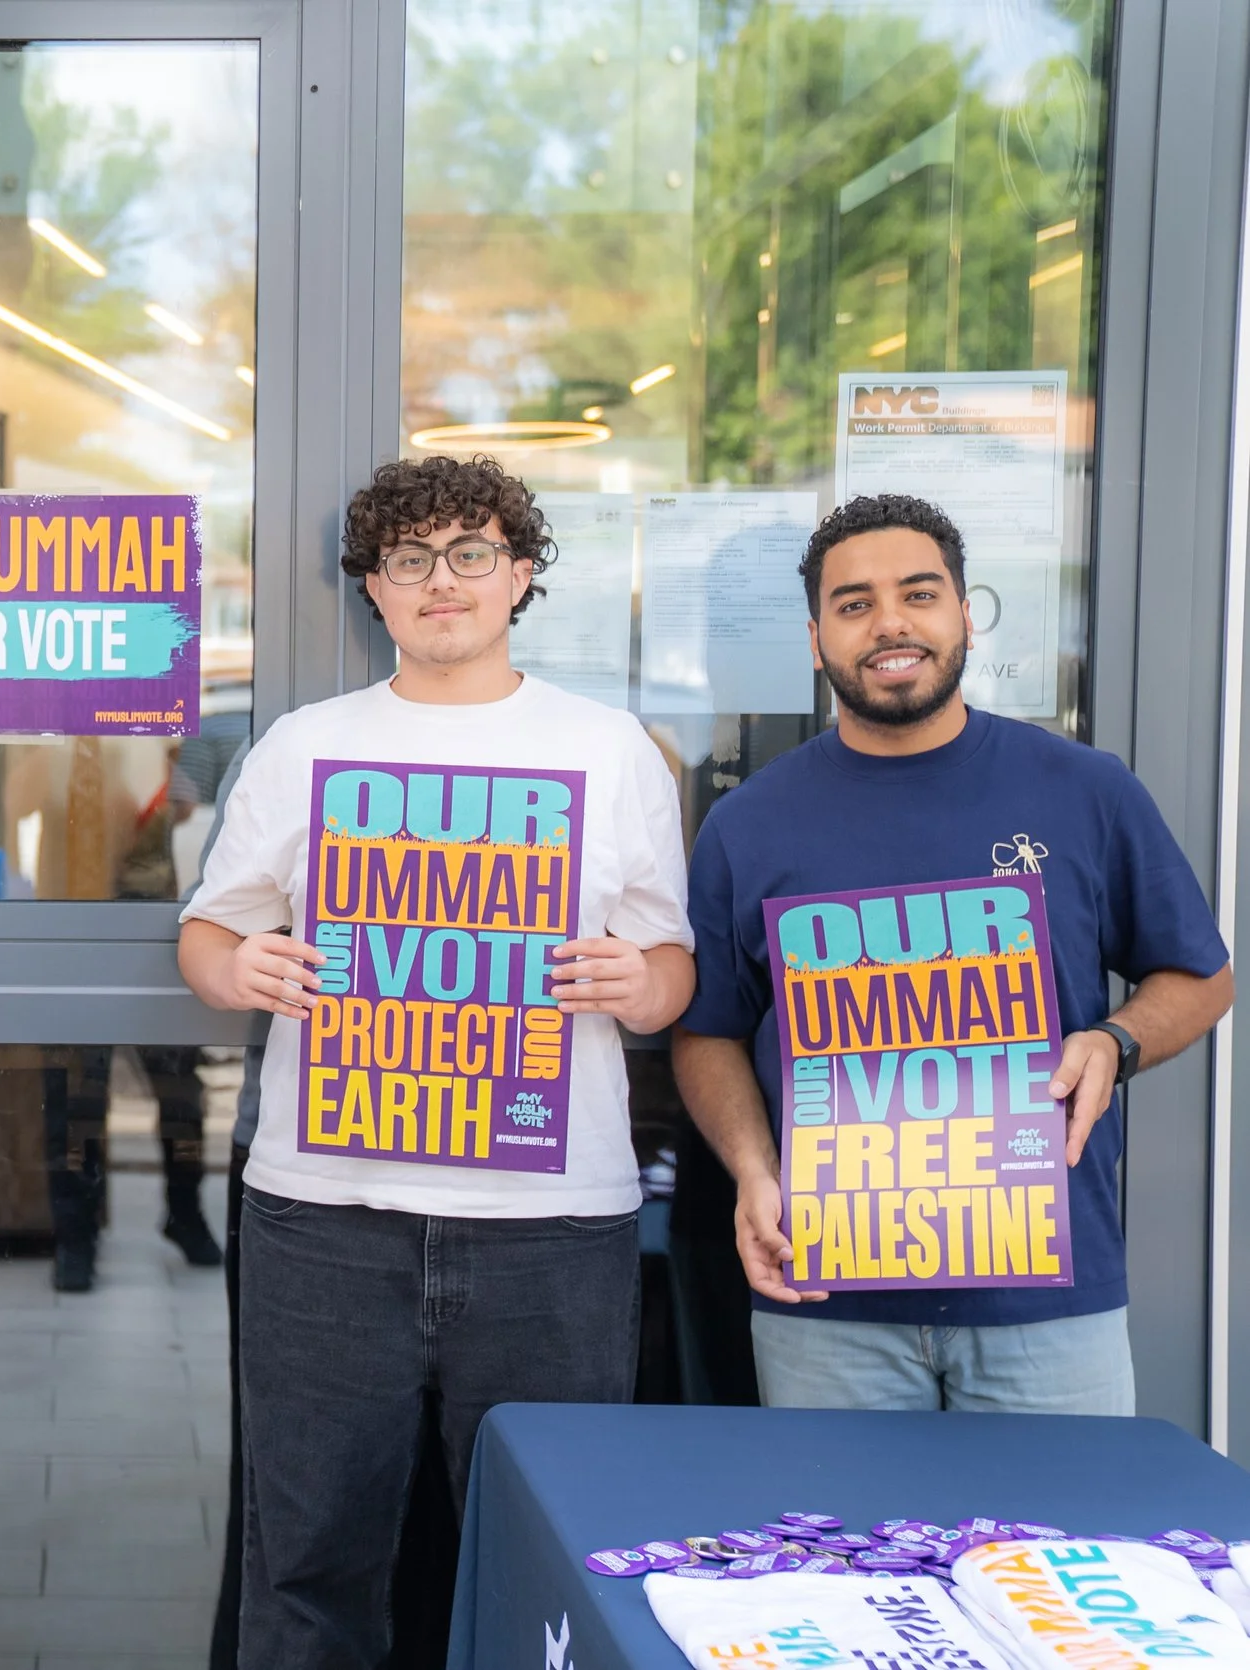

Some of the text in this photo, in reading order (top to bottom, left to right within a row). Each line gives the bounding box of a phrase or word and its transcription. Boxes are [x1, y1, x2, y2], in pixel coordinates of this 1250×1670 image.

[854, 386, 939, 415] NYC
[854, 423, 884, 433] Work
[888, 423, 925, 433] Permit
[928, 423, 987, 435] Department
[18, 608, 126, 671] VOTE
[95, 711, 183, 723] MYMUSLIMVOTE.ORG
[323, 769, 572, 849] OUR
[323, 845, 562, 928] UMMAH
[317, 922, 352, 994] OUR
[778, 886, 1034, 971] OUR
[366, 925, 567, 1006] VOTE
[309, 996, 513, 1077] PROTECT
[791, 962, 1040, 1051] UMMAH
[523, 1008, 563, 1080] OUR
[307, 1066, 492, 1159] EARTH
[506, 1104, 552, 1120] MUSLIM
[793, 1056, 831, 1125] OUR
[842, 1041, 1055, 1123] VOTE
[512, 1115, 545, 1128] VOTE
[791, 1117, 997, 1192] FREE
[1008, 1137, 1049, 1149] MUSLIM
[1014, 1147, 1042, 1156] VOTE
[790, 1185, 1060, 1281] PALESTINE
